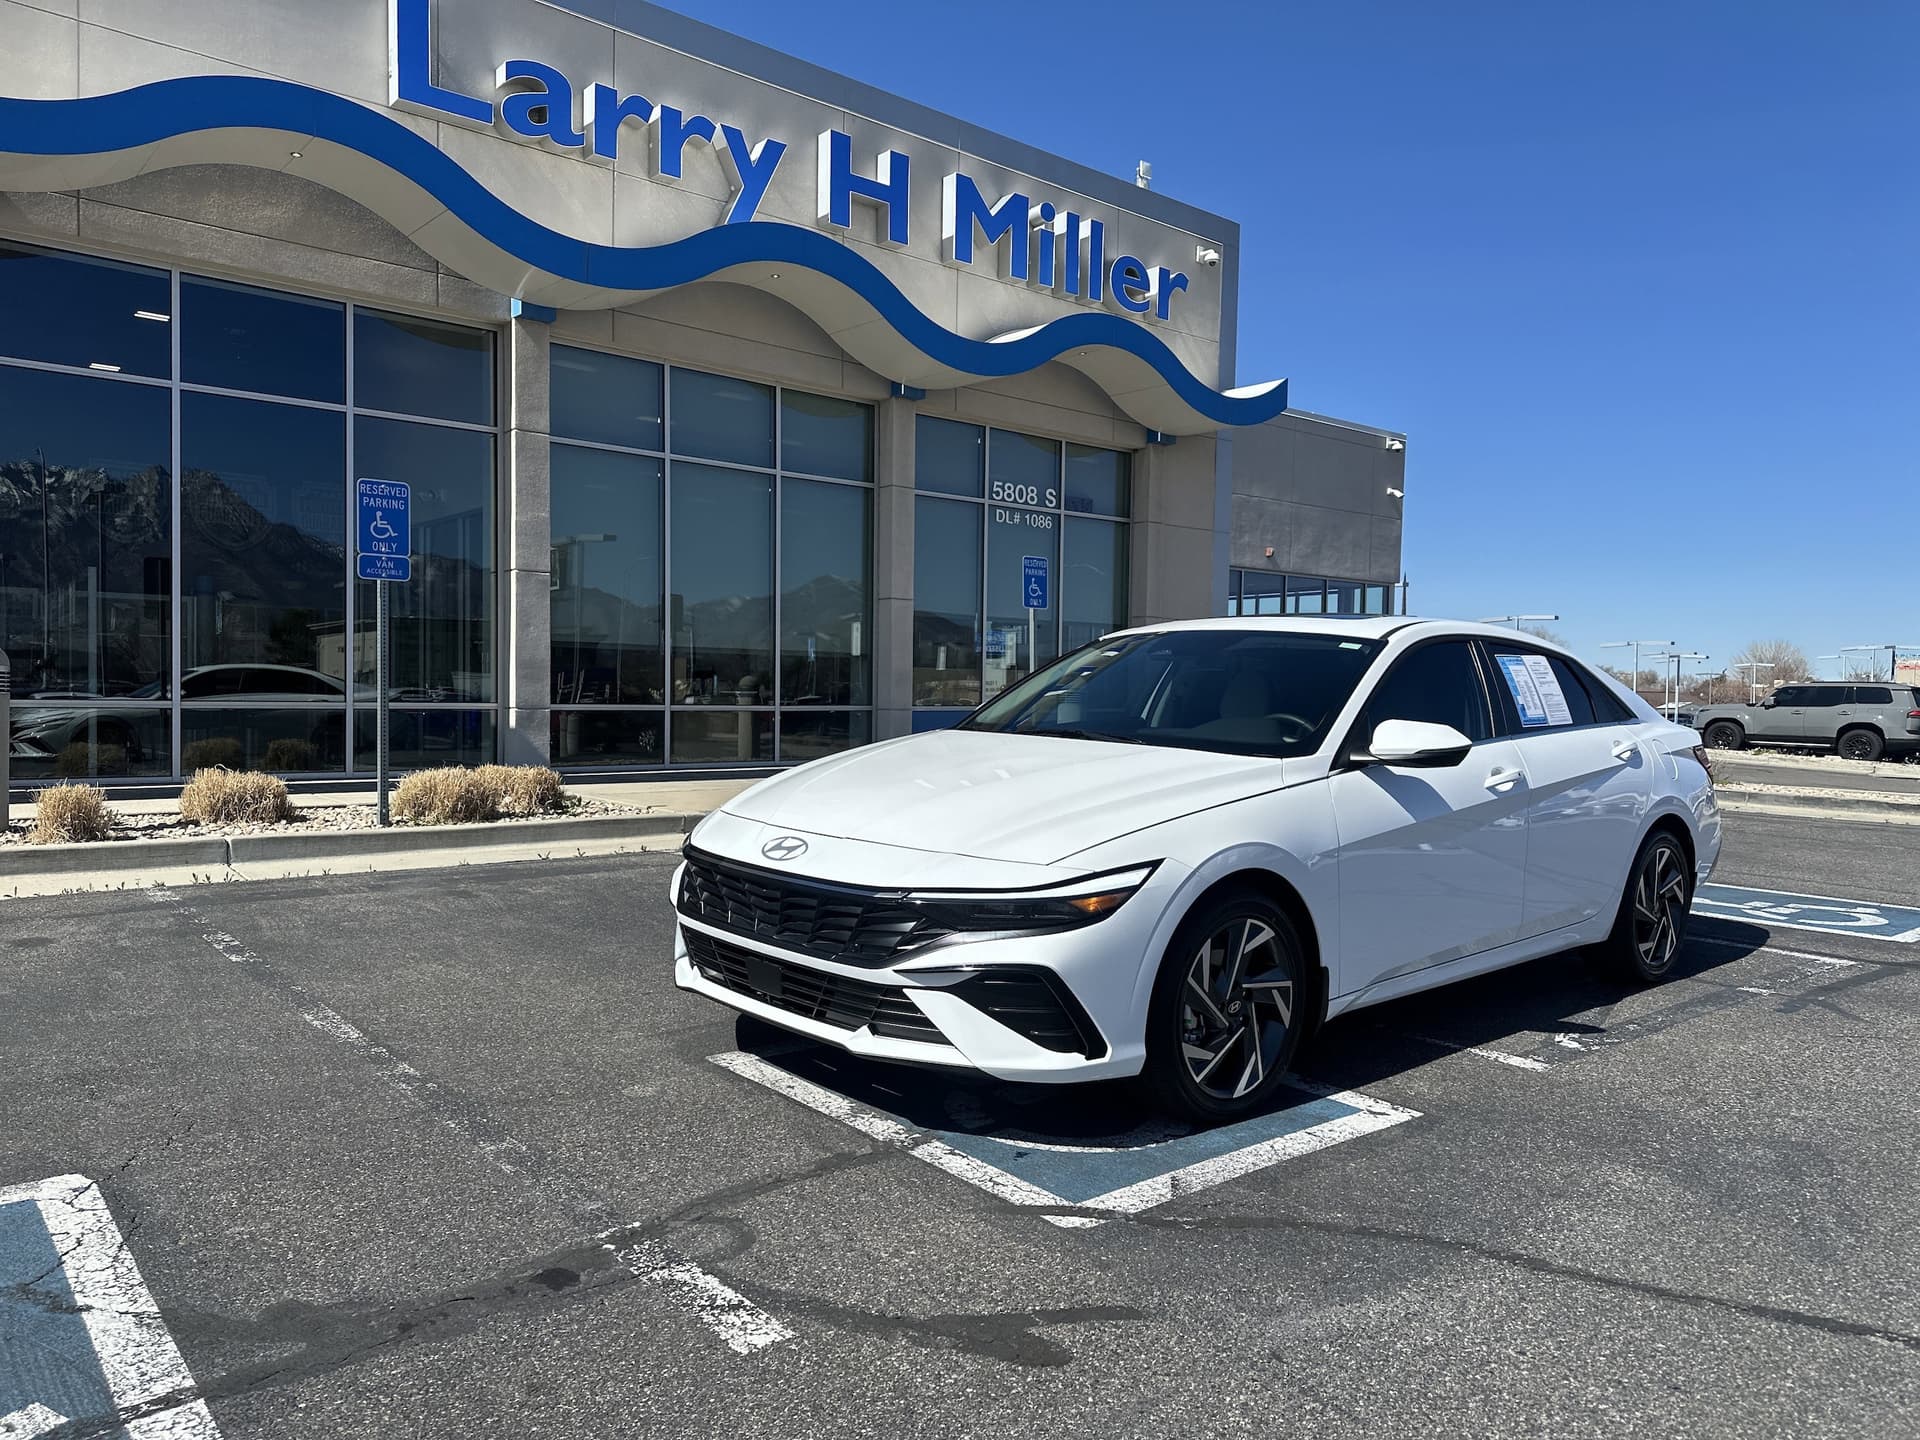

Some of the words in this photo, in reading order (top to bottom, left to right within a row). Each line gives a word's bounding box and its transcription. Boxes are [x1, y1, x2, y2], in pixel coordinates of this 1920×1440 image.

[390, 0, 788, 223] Larry
[820, 128, 911, 246] H
[944, 171, 1190, 321] Miller
[360, 483, 408, 498] RESERVED
[992, 481, 1038, 505] 5808
[1045, 488, 1057, 508] S
[363, 496, 405, 510] PARKING
[996, 508, 1021, 525] DL#
[1024, 513, 1052, 529] 1086
[372, 541, 398, 553] ONLY
[376, 559, 394, 569] VAN
[366, 568, 403, 576] ACCESSIBLE
[1025, 567, 1046, 576] PARKING
